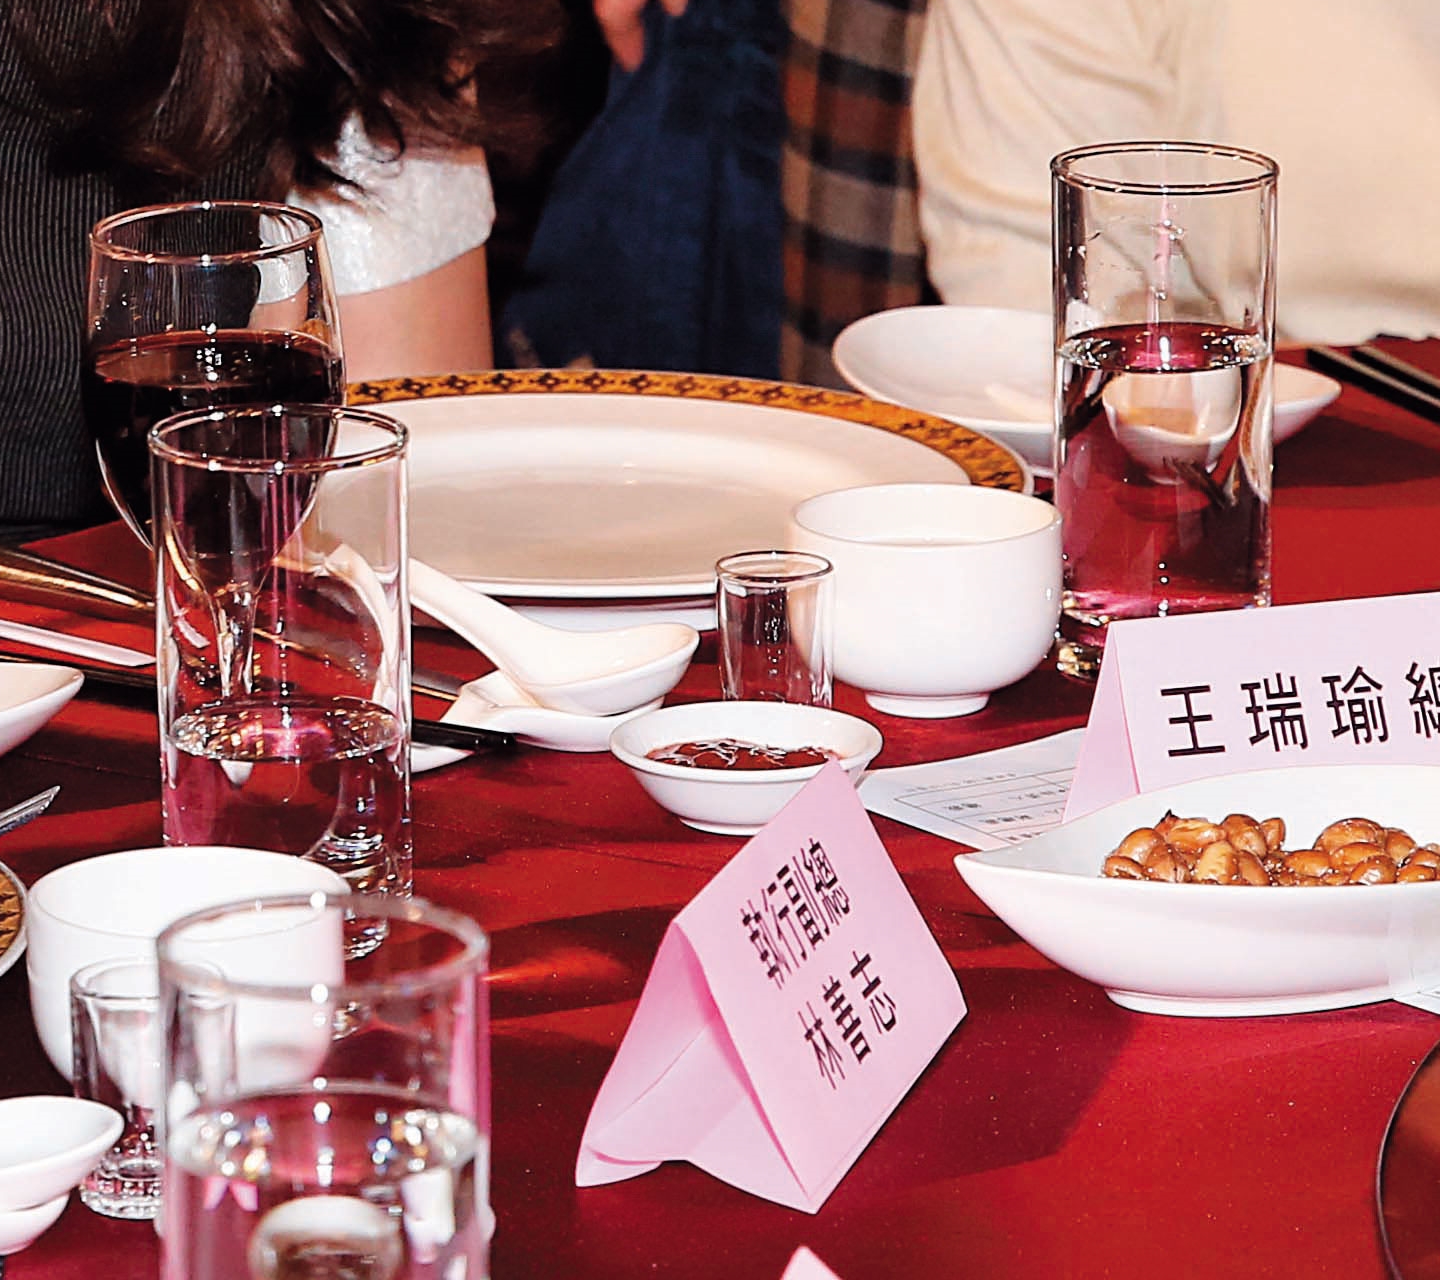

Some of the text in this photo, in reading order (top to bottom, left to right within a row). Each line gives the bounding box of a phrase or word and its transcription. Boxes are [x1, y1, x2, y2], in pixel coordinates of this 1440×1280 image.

[739, 837, 851, 991] 執行副總
[797, 950, 898, 1090] 林善志
